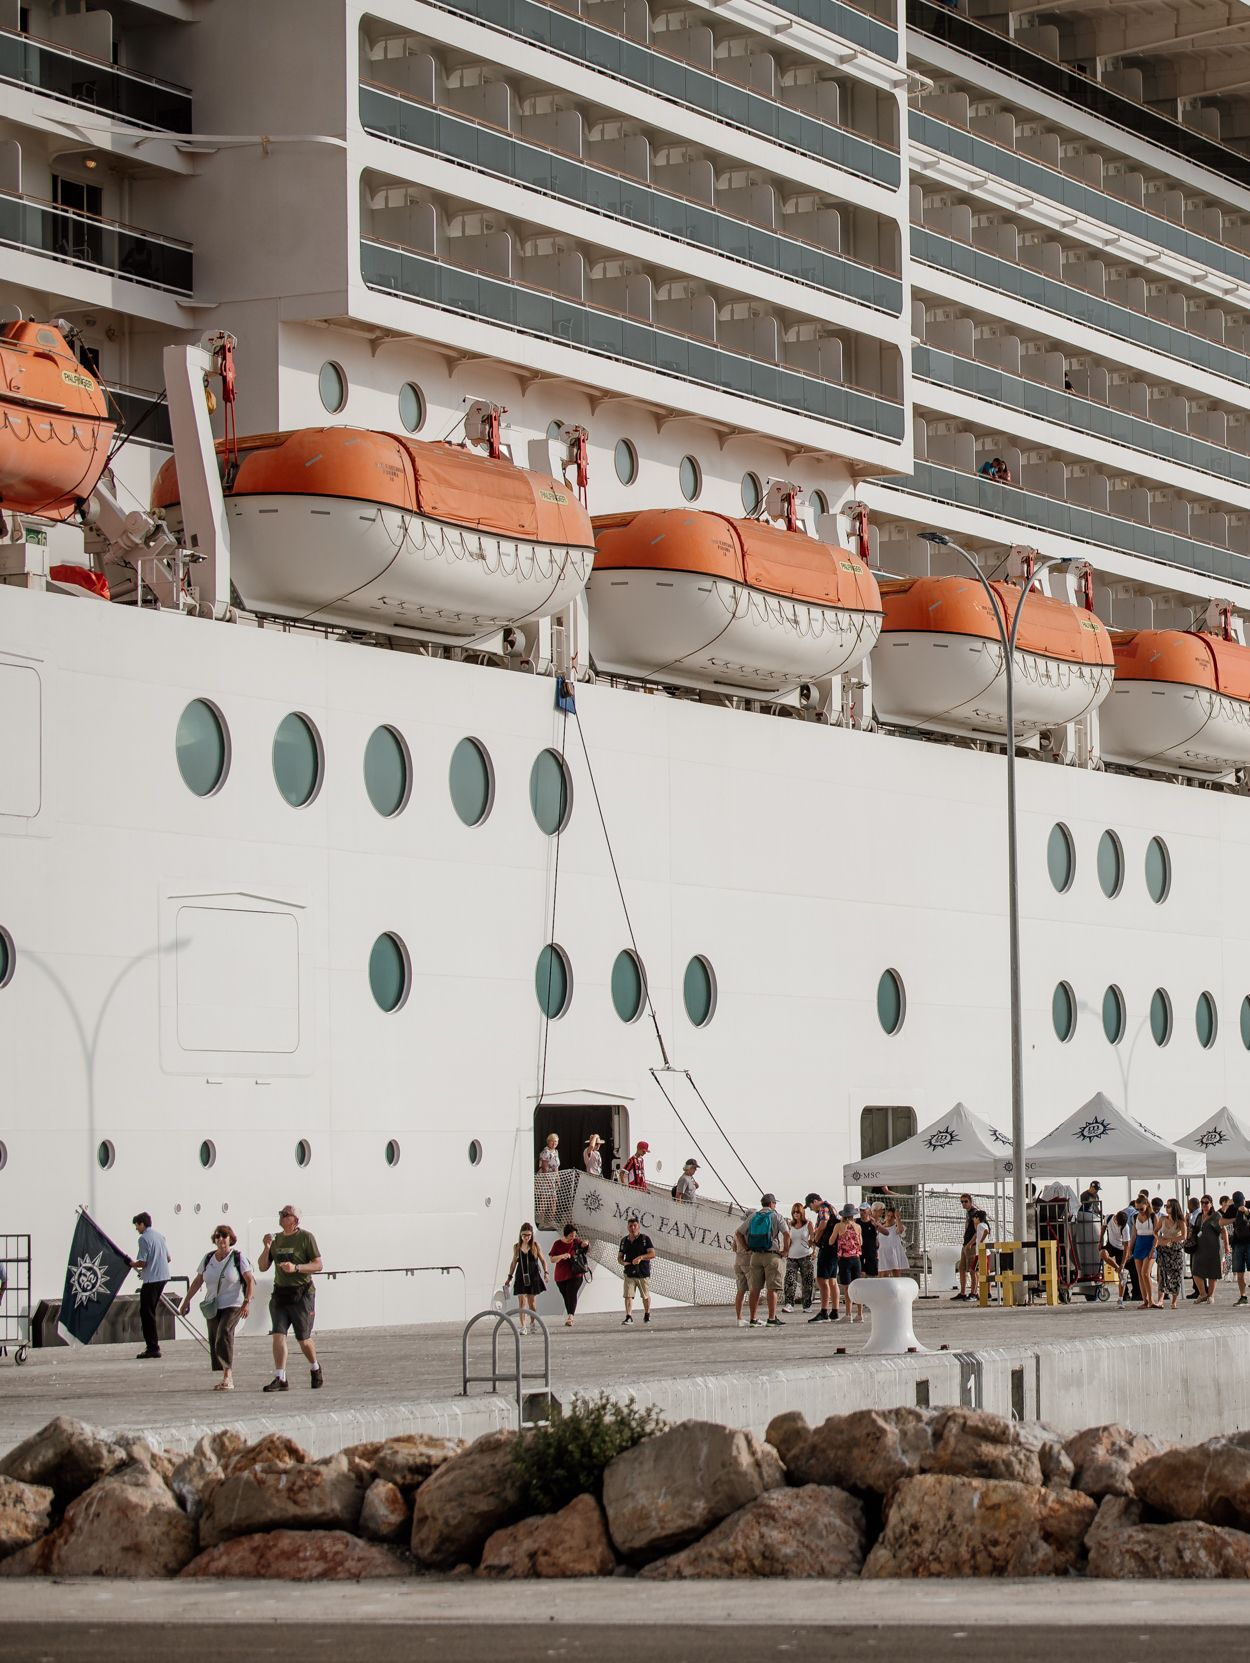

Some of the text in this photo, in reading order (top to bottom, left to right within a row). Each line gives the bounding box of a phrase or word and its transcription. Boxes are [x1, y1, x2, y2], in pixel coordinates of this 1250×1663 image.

[863, 1171, 881, 1179] MSC
[612, 1202, 655, 1229] MSC
[656, 1215, 734, 1251] FANTAS
[966, 1373, 976, 1408] 1
